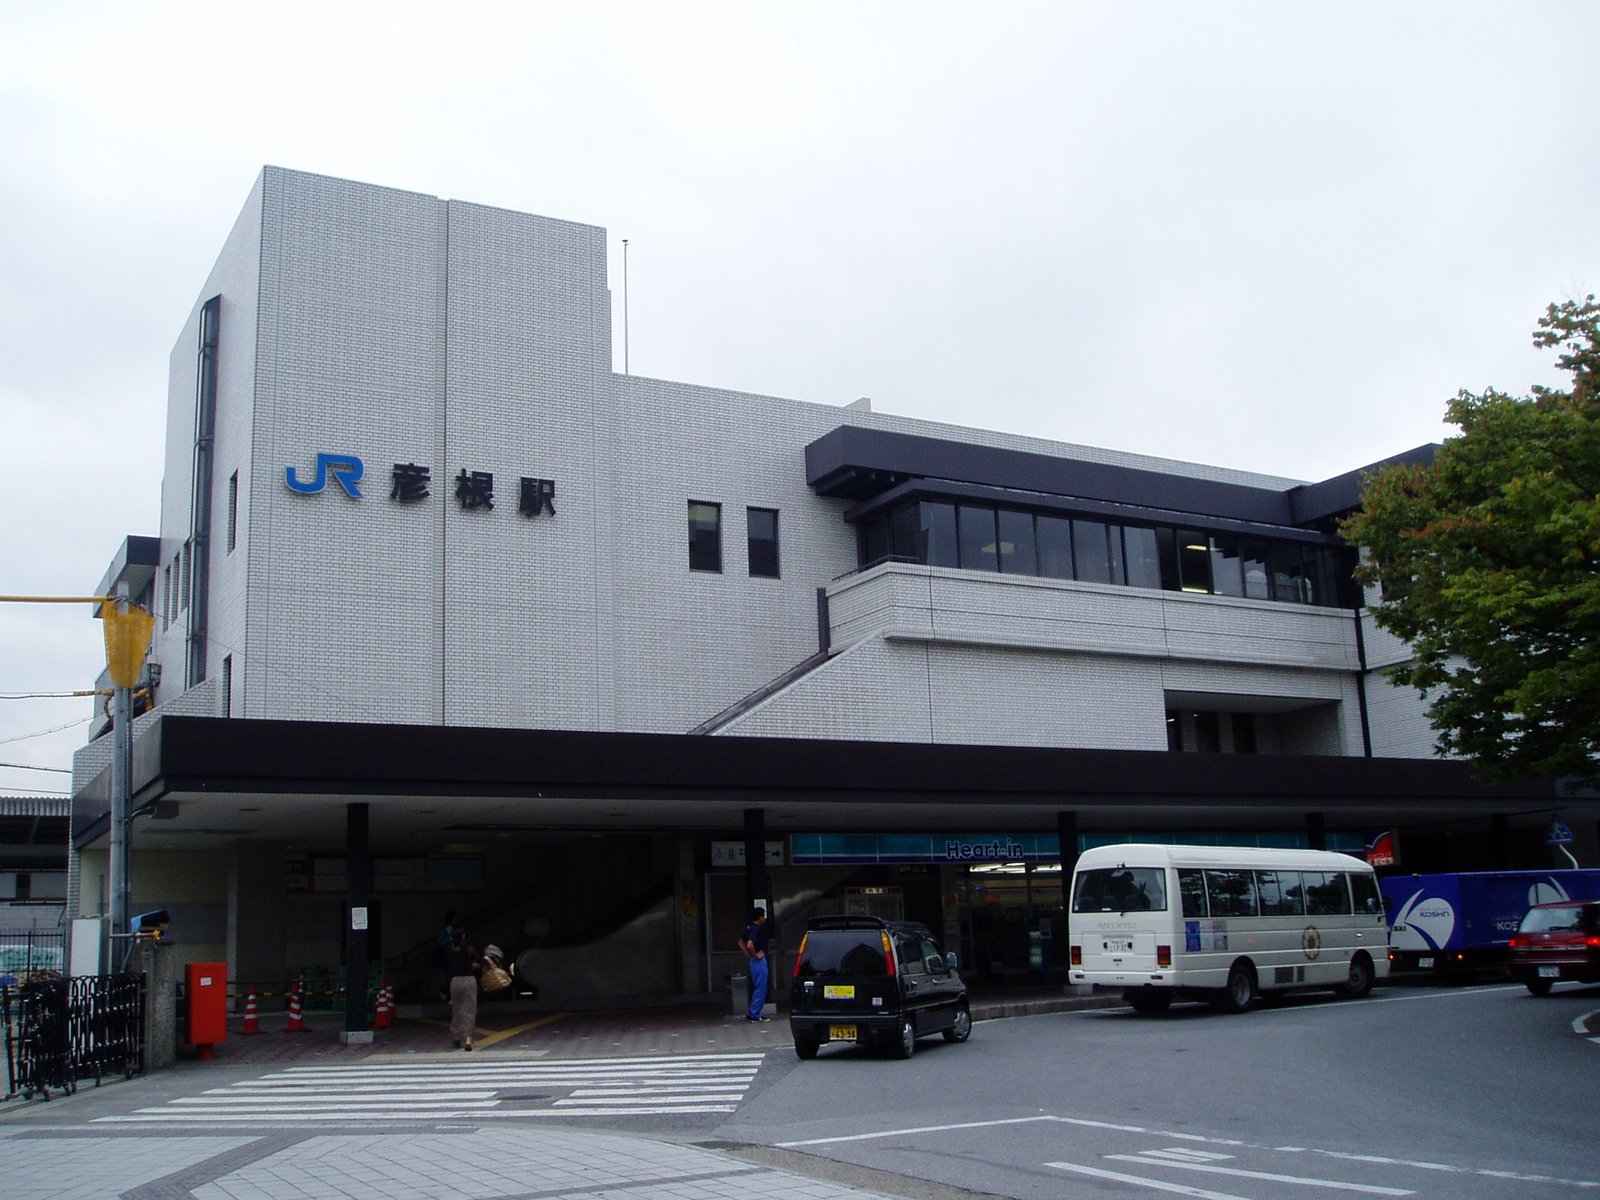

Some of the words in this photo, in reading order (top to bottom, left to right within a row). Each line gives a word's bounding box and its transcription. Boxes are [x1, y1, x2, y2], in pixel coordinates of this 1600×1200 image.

[284, 453, 364, 498] JR
[390, 462, 557, 517] 彦根駅
